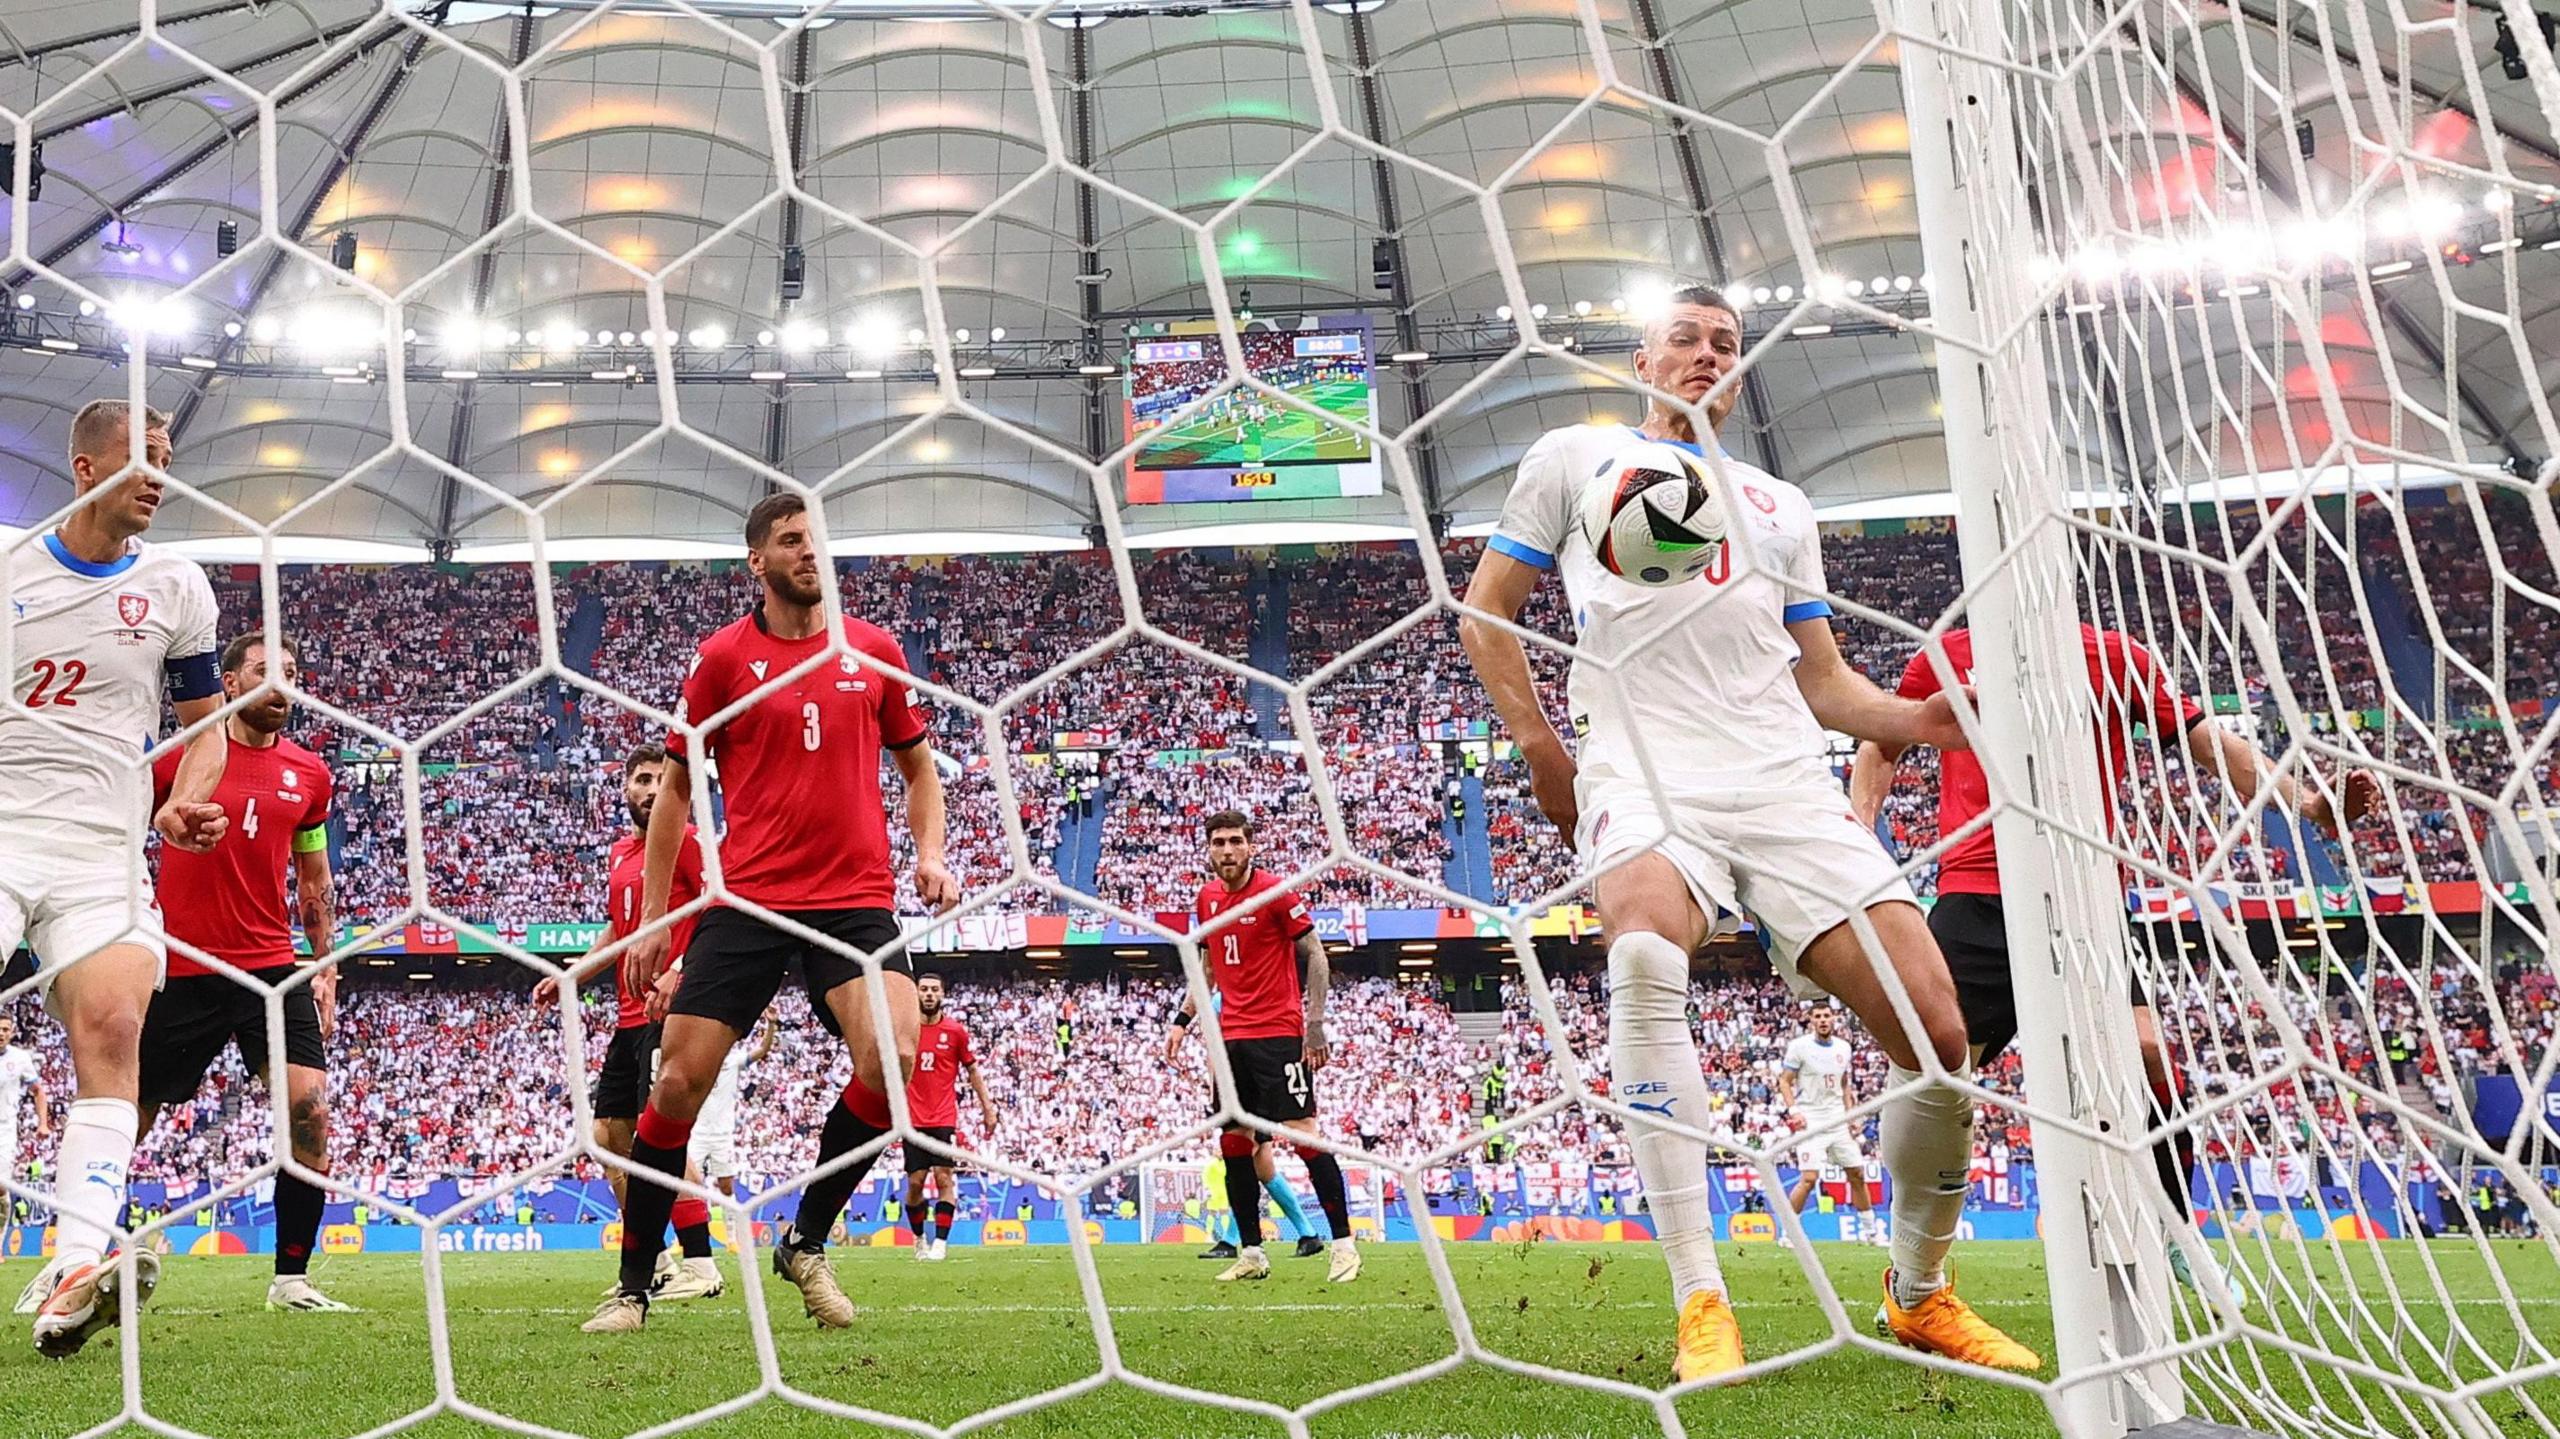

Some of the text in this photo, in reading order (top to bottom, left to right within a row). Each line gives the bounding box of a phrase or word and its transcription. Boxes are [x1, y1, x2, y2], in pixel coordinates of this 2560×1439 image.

[25, 658, 87, 709] 22
[803, 702, 821, 751] 3
[242, 797, 258, 839] 4
[624, 886, 632, 921] 9
[1224, 934, 1241, 965] 21
[920, 1051, 935, 1071] 22
[1284, 1062, 1309, 1094] 21
[1623, 1082, 1668, 1095] CZE
[1823, 1073, 1835, 1099] 15
[86, 1161, 122, 1176] CZE
[472, 1226, 543, 1251] fresh
